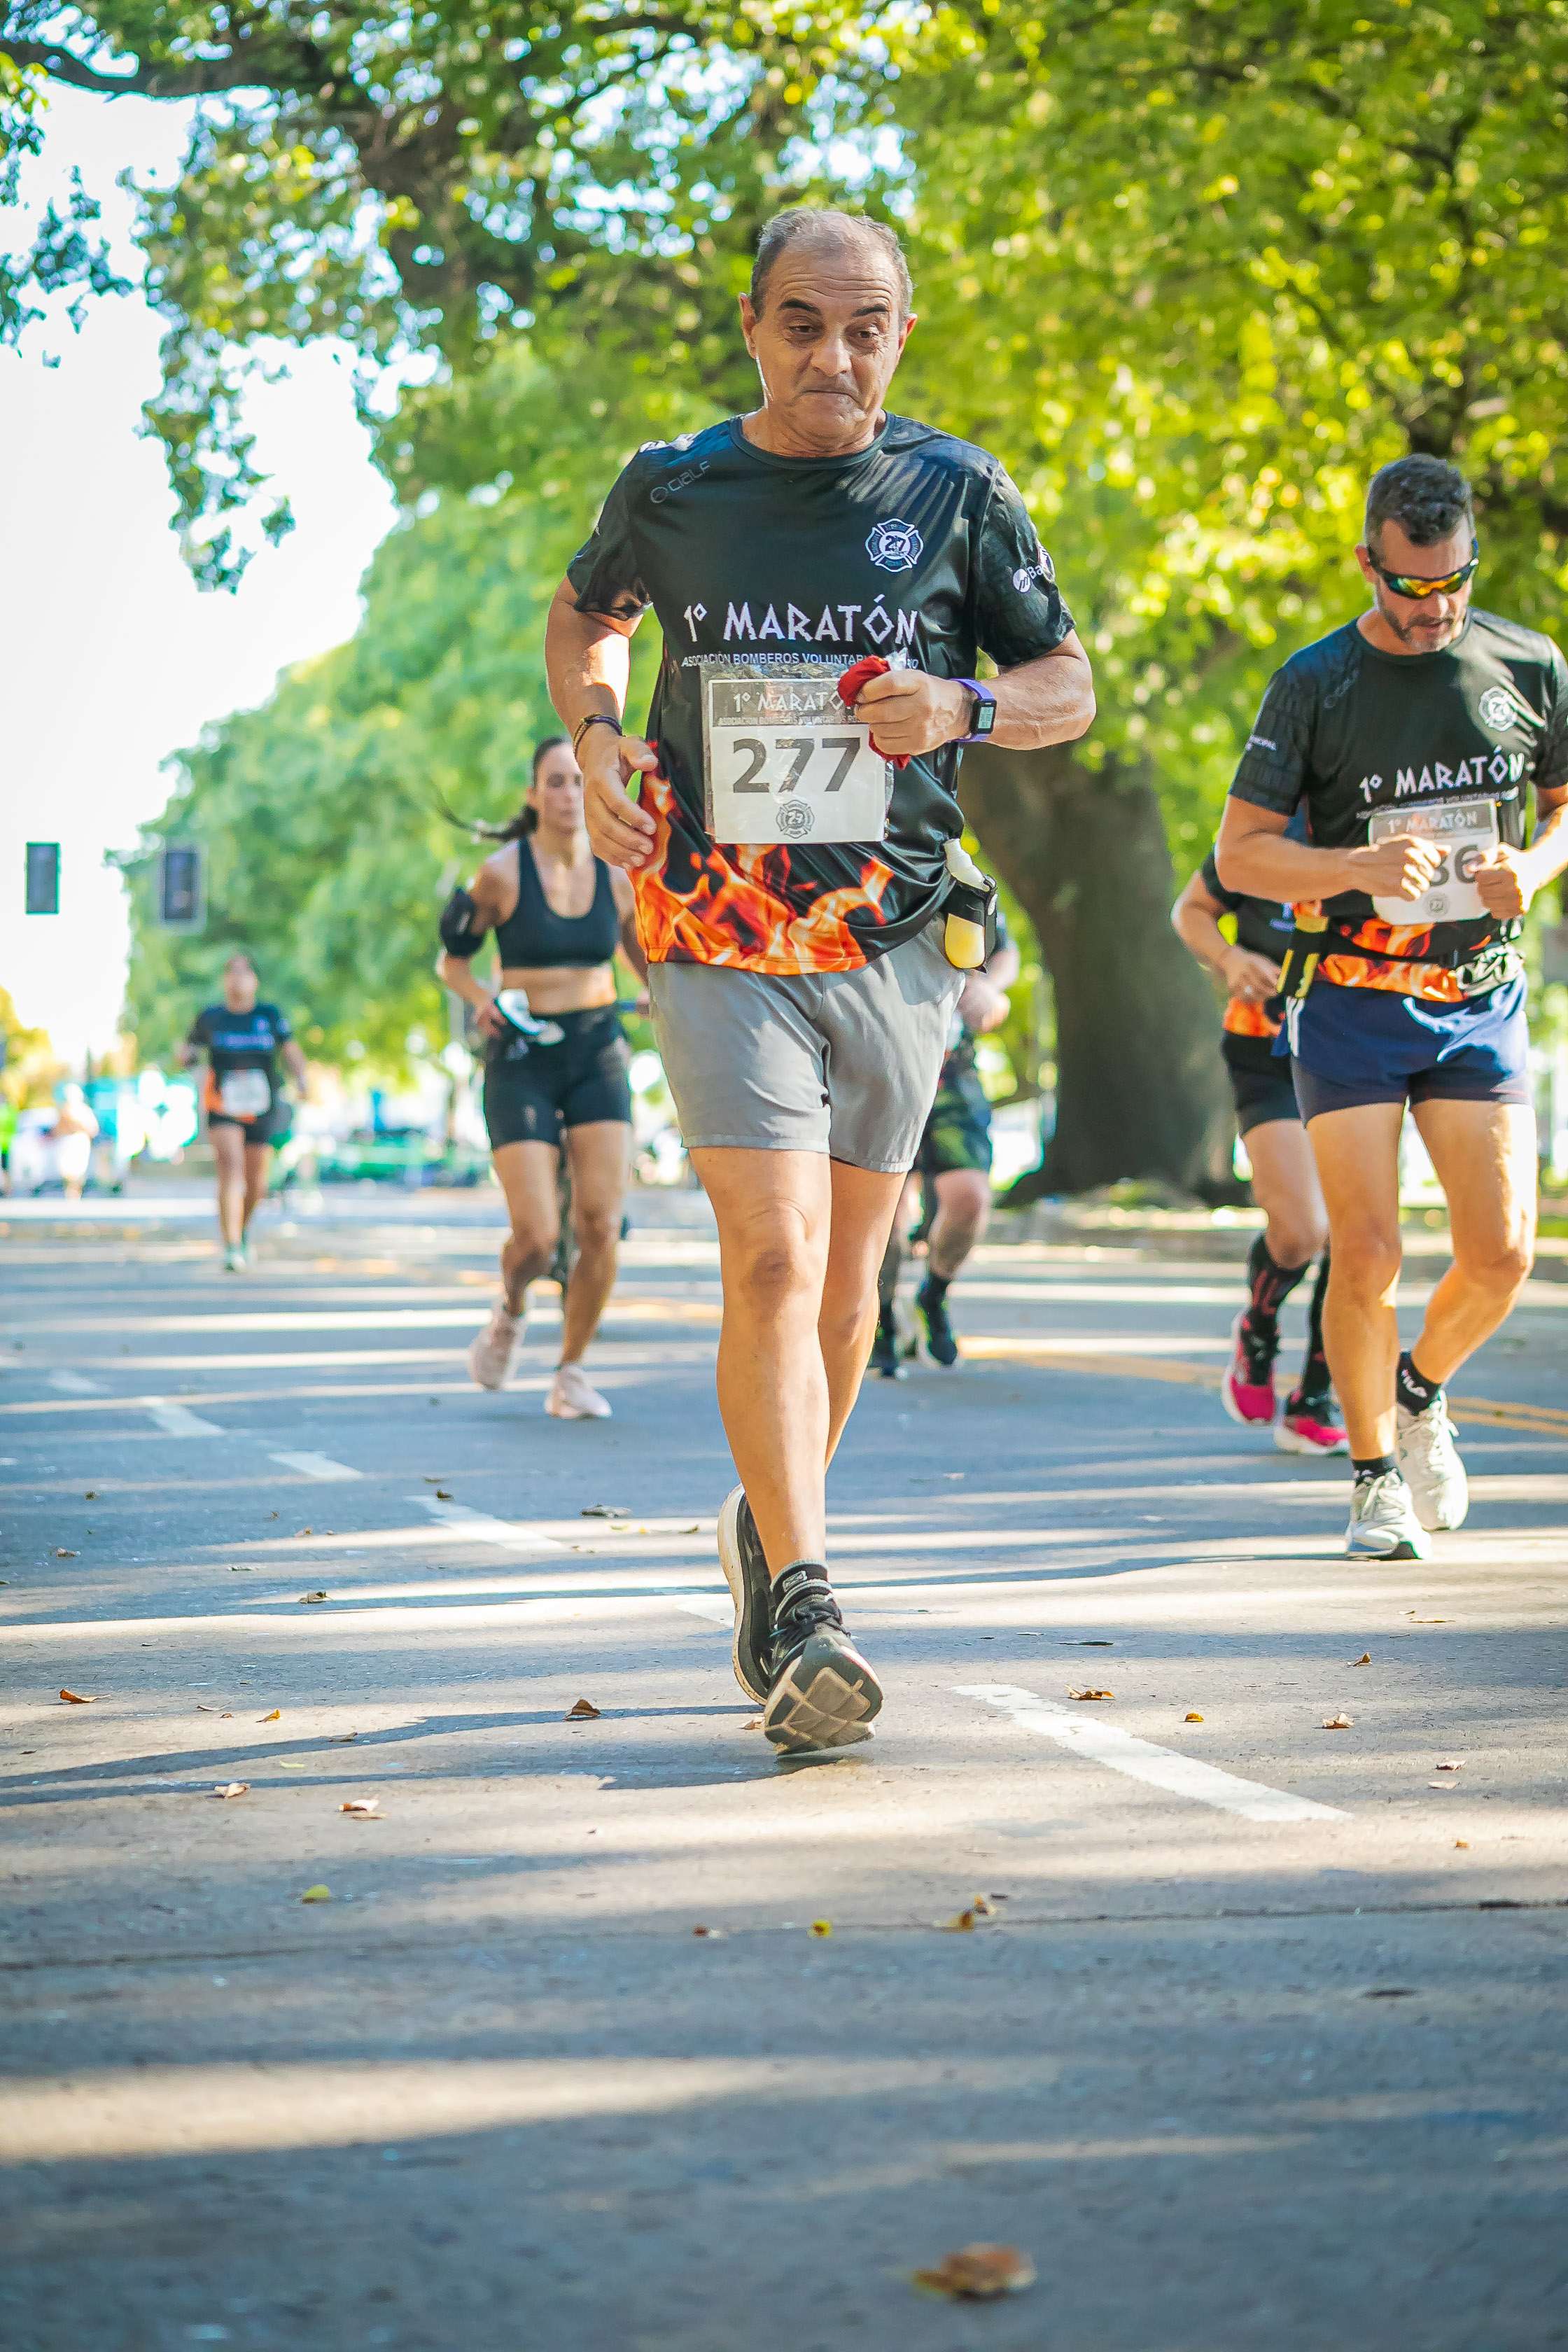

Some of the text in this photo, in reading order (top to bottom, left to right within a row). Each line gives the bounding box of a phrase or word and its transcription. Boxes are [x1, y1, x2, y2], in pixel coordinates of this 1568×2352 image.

[884, 535, 906, 552] 27
[723, 594, 918, 645] MARATÓN
[733, 653, 799, 665] BOMBEROS
[757, 685, 852, 712] MARATÓ
[733, 737, 861, 793] 277
[1394, 745, 1525, 798] MARATÓN
